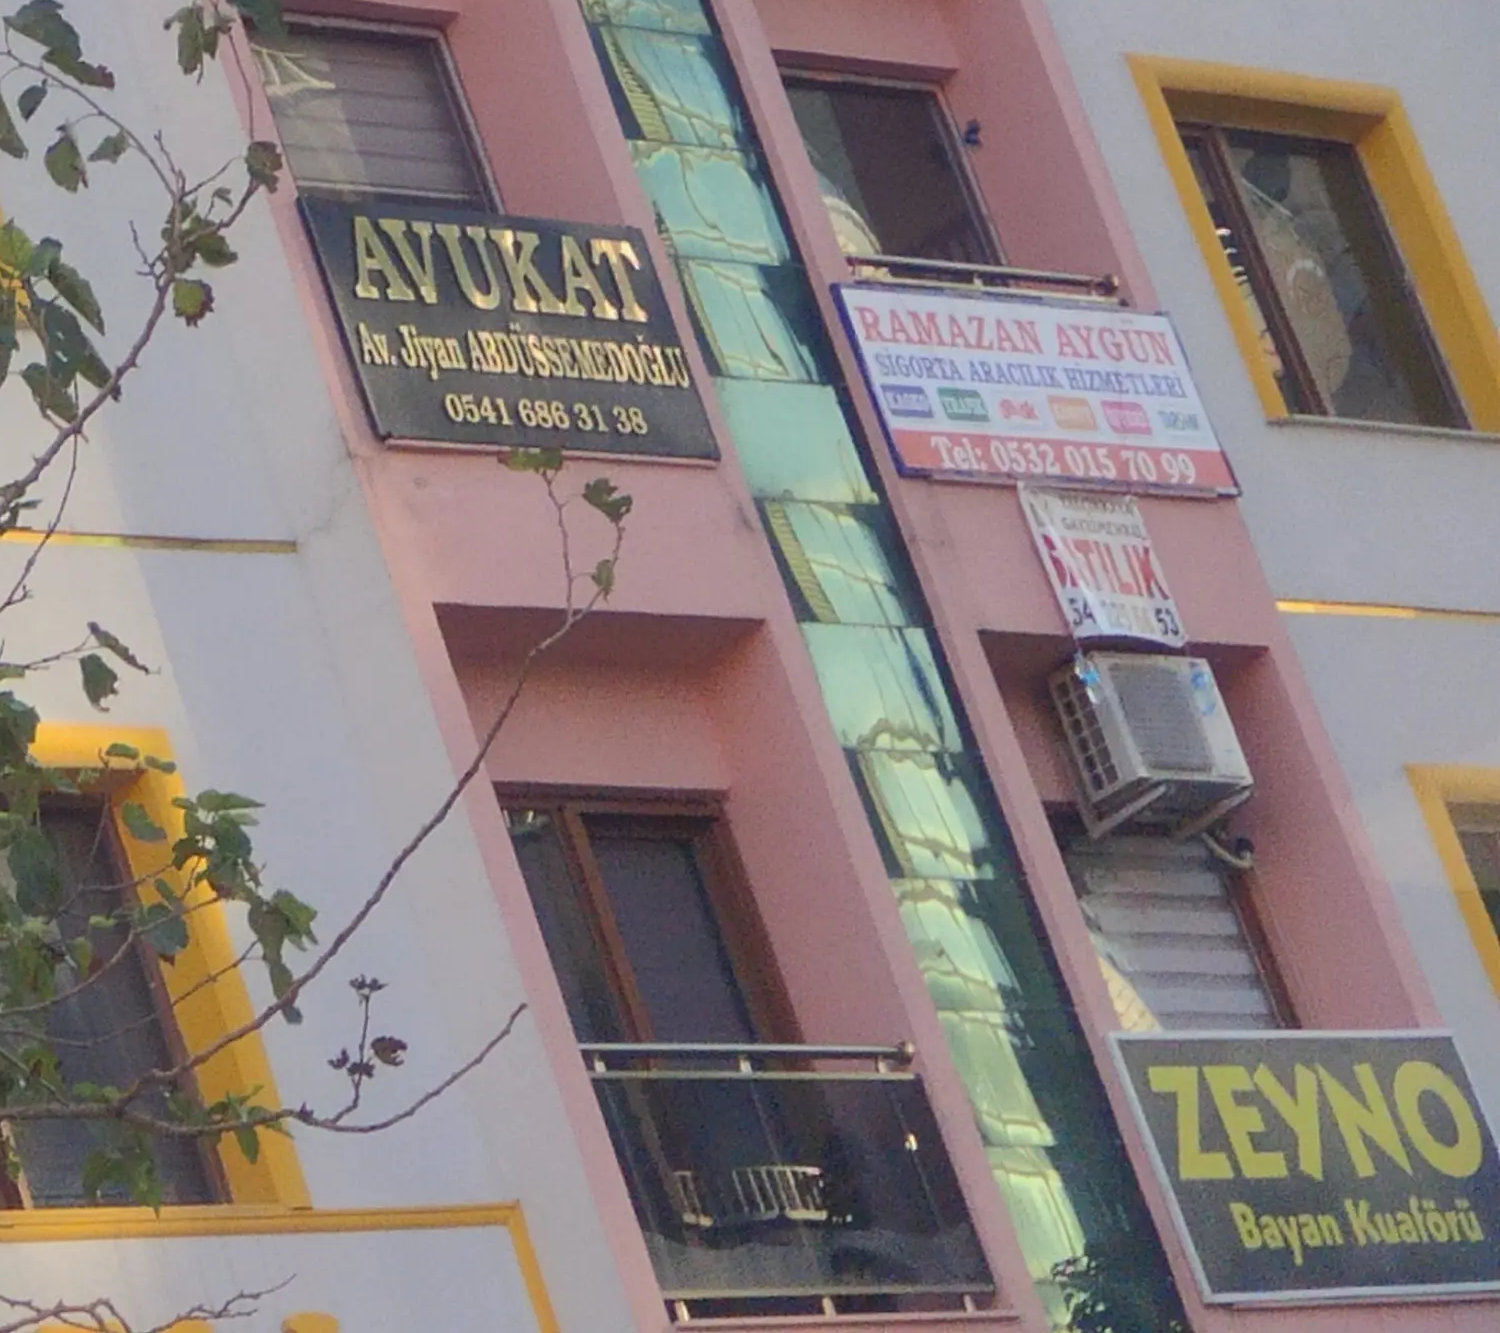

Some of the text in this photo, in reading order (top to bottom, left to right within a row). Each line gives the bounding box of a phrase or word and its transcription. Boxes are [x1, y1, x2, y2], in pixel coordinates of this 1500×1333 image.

[354, 216, 648, 323] AVUKAT
[358, 321, 692, 389] Av. Jiyan ABDÜSSEMEDOĞLU
[855, 306, 1176, 366] RAMAZAN AYGÜN
[874, 349, 1189, 399] SİGORTA ARACILIK HİZMETLERİ
[445, 393, 649, 436] 0541 686 31 38
[931, 437, 1196, 484] Tel: 0532 015 70 99
[1148, 1061, 1483, 1180] ZEYNO
[1230, 1197, 1484, 1267] Bayan Kuaförü
